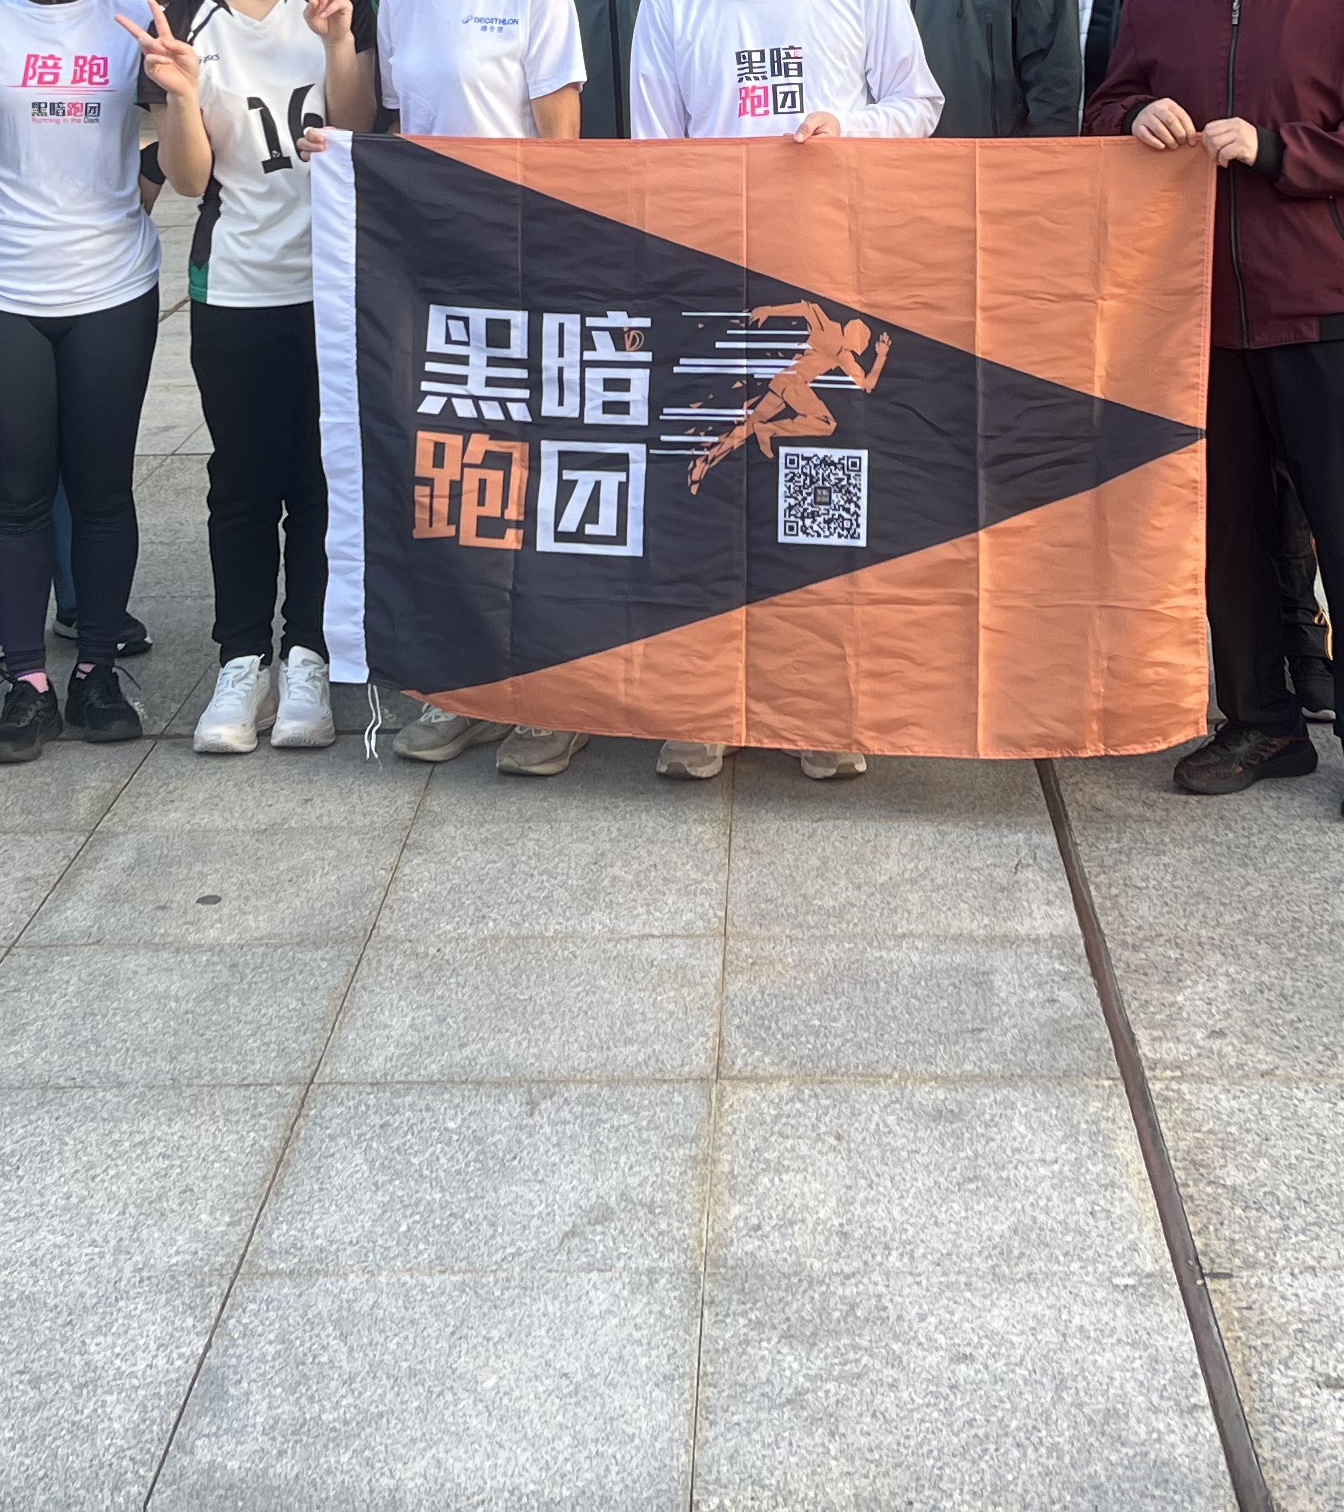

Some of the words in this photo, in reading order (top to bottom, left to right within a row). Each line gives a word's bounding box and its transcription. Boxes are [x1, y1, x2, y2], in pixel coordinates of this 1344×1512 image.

[474, 16, 519, 25] DECATHLON
[21, 53, 110, 87] 陪跑
[735, 45, 803, 83] 黑暗
[31, 101, 101, 117] 黑暗跑团
[738, 82, 804, 118] 跑团
[31, 116, 61, 125] Running
[247, 83, 323, 174] 16
[417, 304, 653, 426] 黑暗
[413, 430, 647, 557] 跑团
